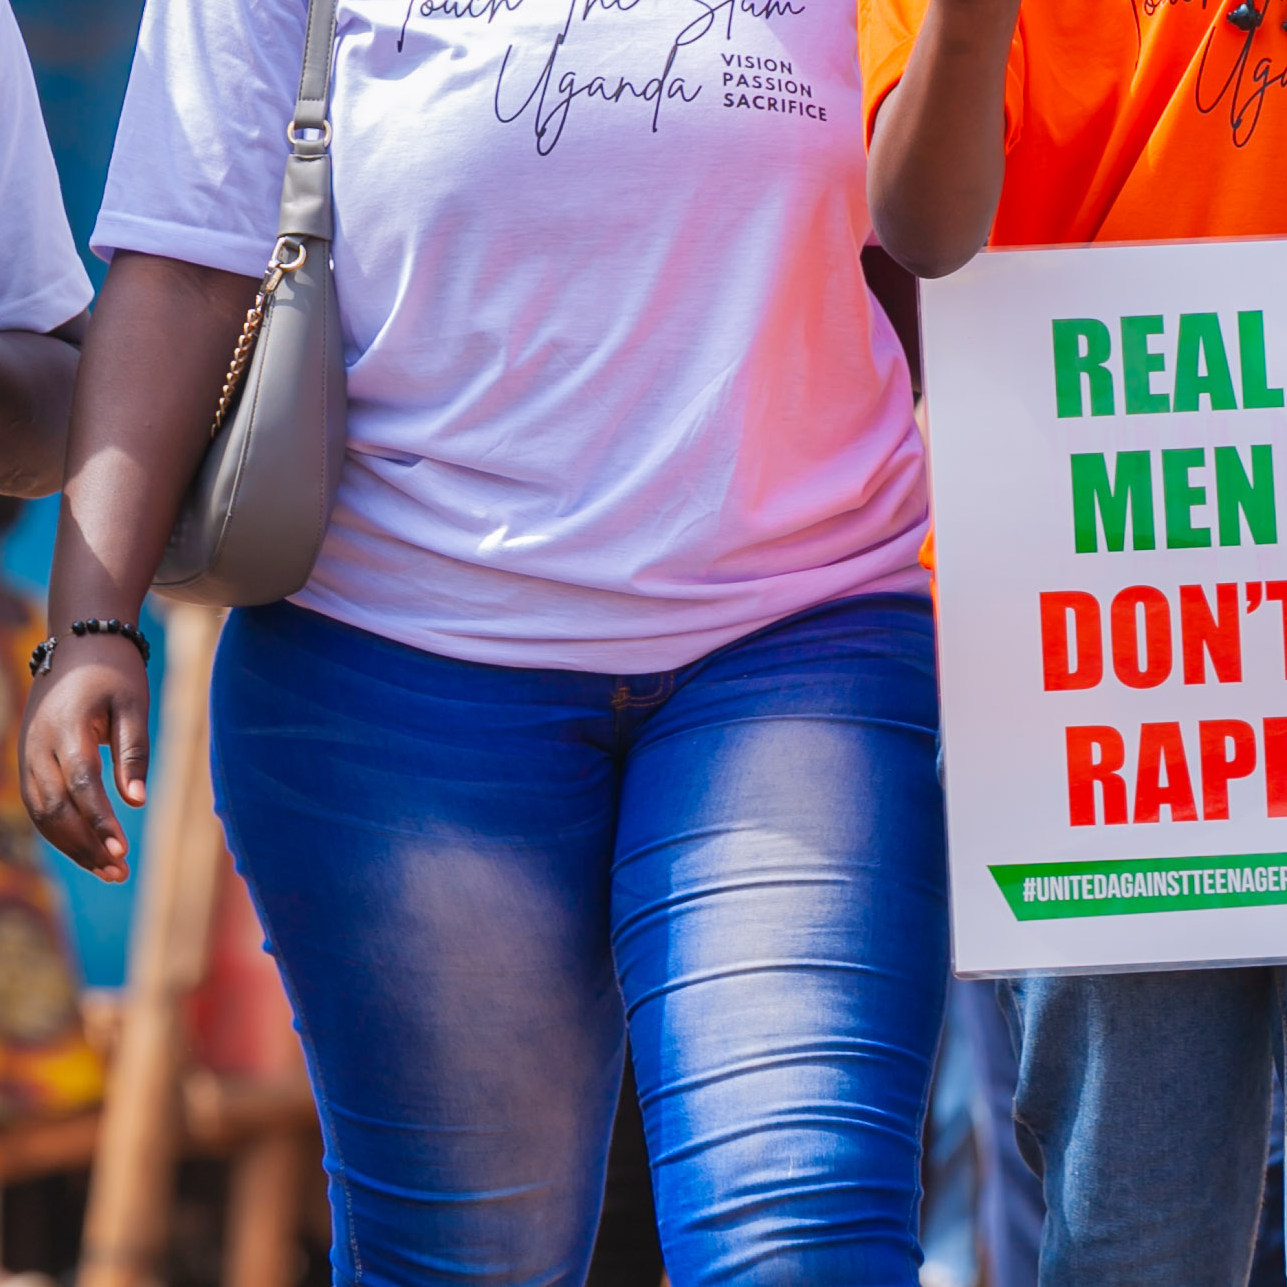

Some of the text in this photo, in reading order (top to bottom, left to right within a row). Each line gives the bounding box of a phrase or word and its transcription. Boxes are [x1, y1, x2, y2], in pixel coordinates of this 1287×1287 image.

[494, 38, 703, 156] Uganda
[721, 52, 793, 76] VISION
[722, 71, 813, 99] PASSION
[723, 92, 829, 122] SACRIFICE
[1051, 310, 1285, 418] REAL
[1069, 444, 1278, 554] MEN
